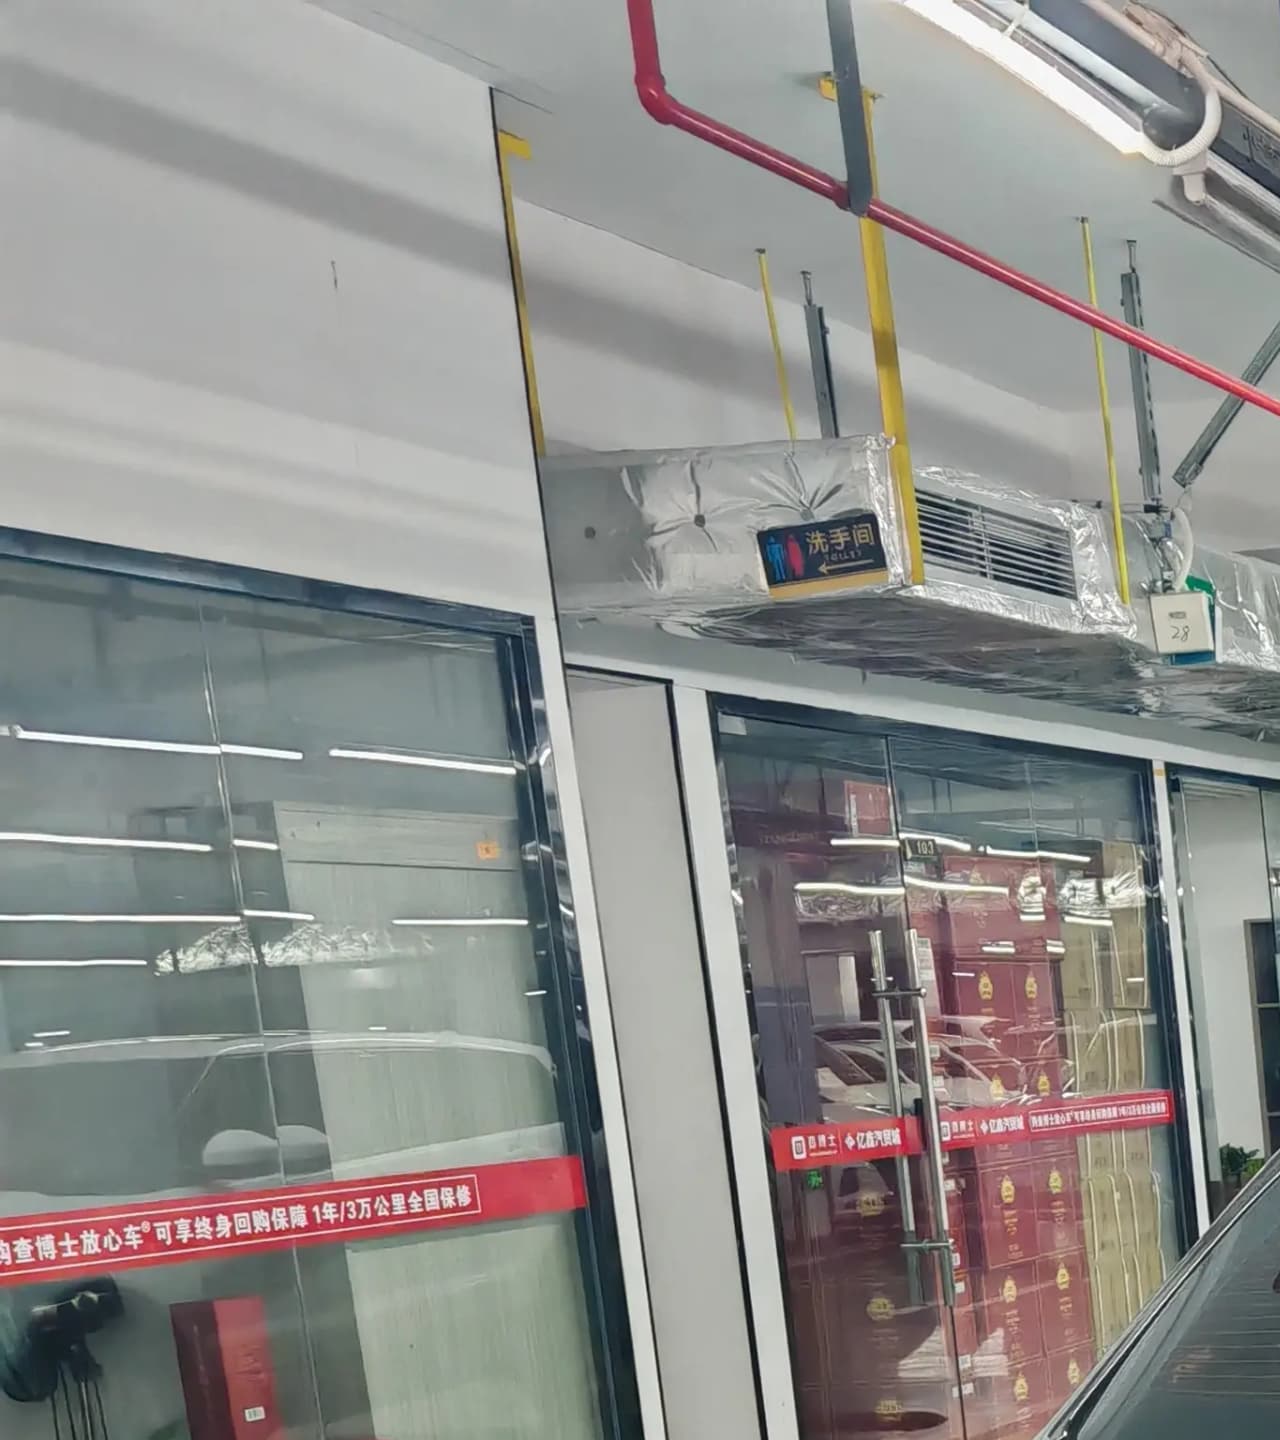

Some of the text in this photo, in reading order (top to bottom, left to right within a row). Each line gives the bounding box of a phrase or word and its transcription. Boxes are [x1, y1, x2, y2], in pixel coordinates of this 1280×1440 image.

[806, 523, 875, 555] 洗手间
[1170, 625, 1190, 641] 28
